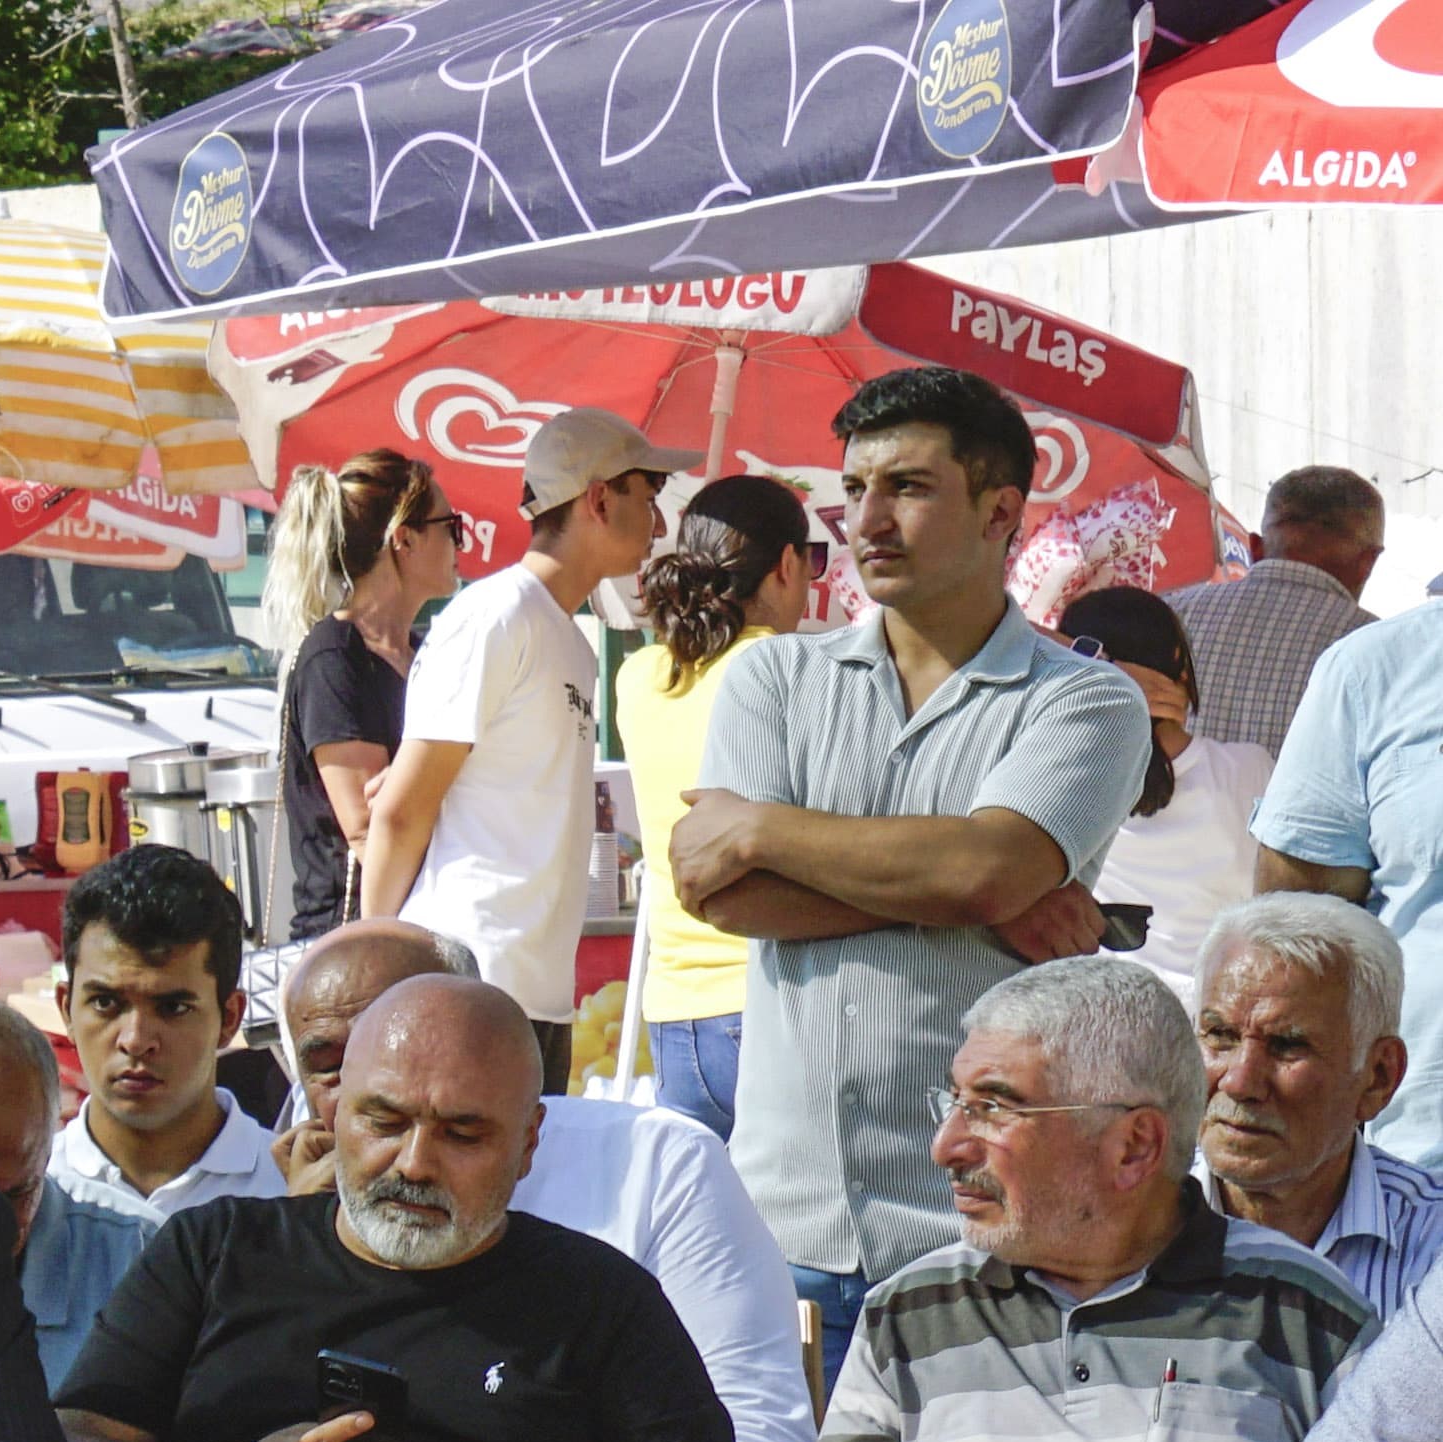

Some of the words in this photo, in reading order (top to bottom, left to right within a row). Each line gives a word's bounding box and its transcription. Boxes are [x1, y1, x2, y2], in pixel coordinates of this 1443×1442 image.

[952, 18, 1004, 50] Meşhur
[921, 40, 1002, 107] Dövme
[174, 190, 245, 250] Dövme
